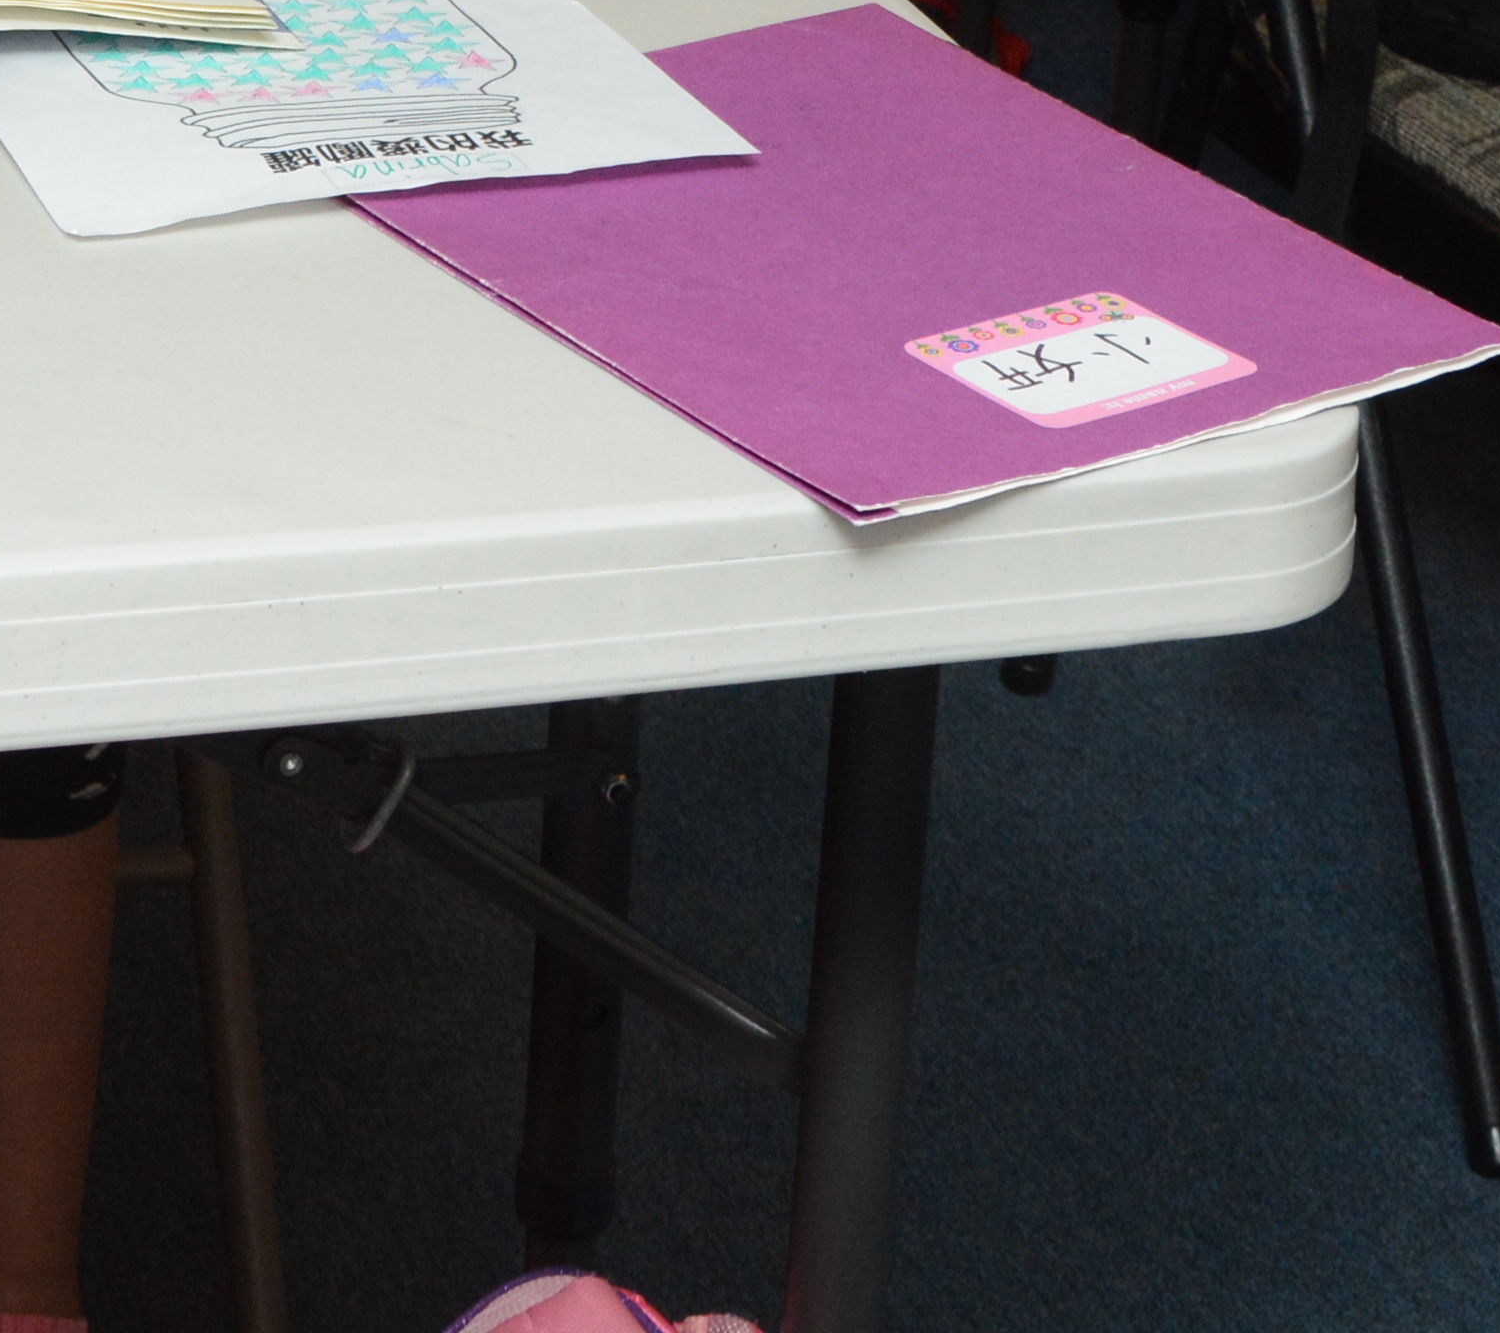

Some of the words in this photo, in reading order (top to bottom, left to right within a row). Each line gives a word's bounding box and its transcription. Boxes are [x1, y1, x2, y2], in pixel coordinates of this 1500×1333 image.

[259, 128, 534, 175] 我的獎勵罐
[335, 151, 513, 183] Sabrina
[1122, 386, 1164, 408] name
[1170, 378, 1196, 393] my
